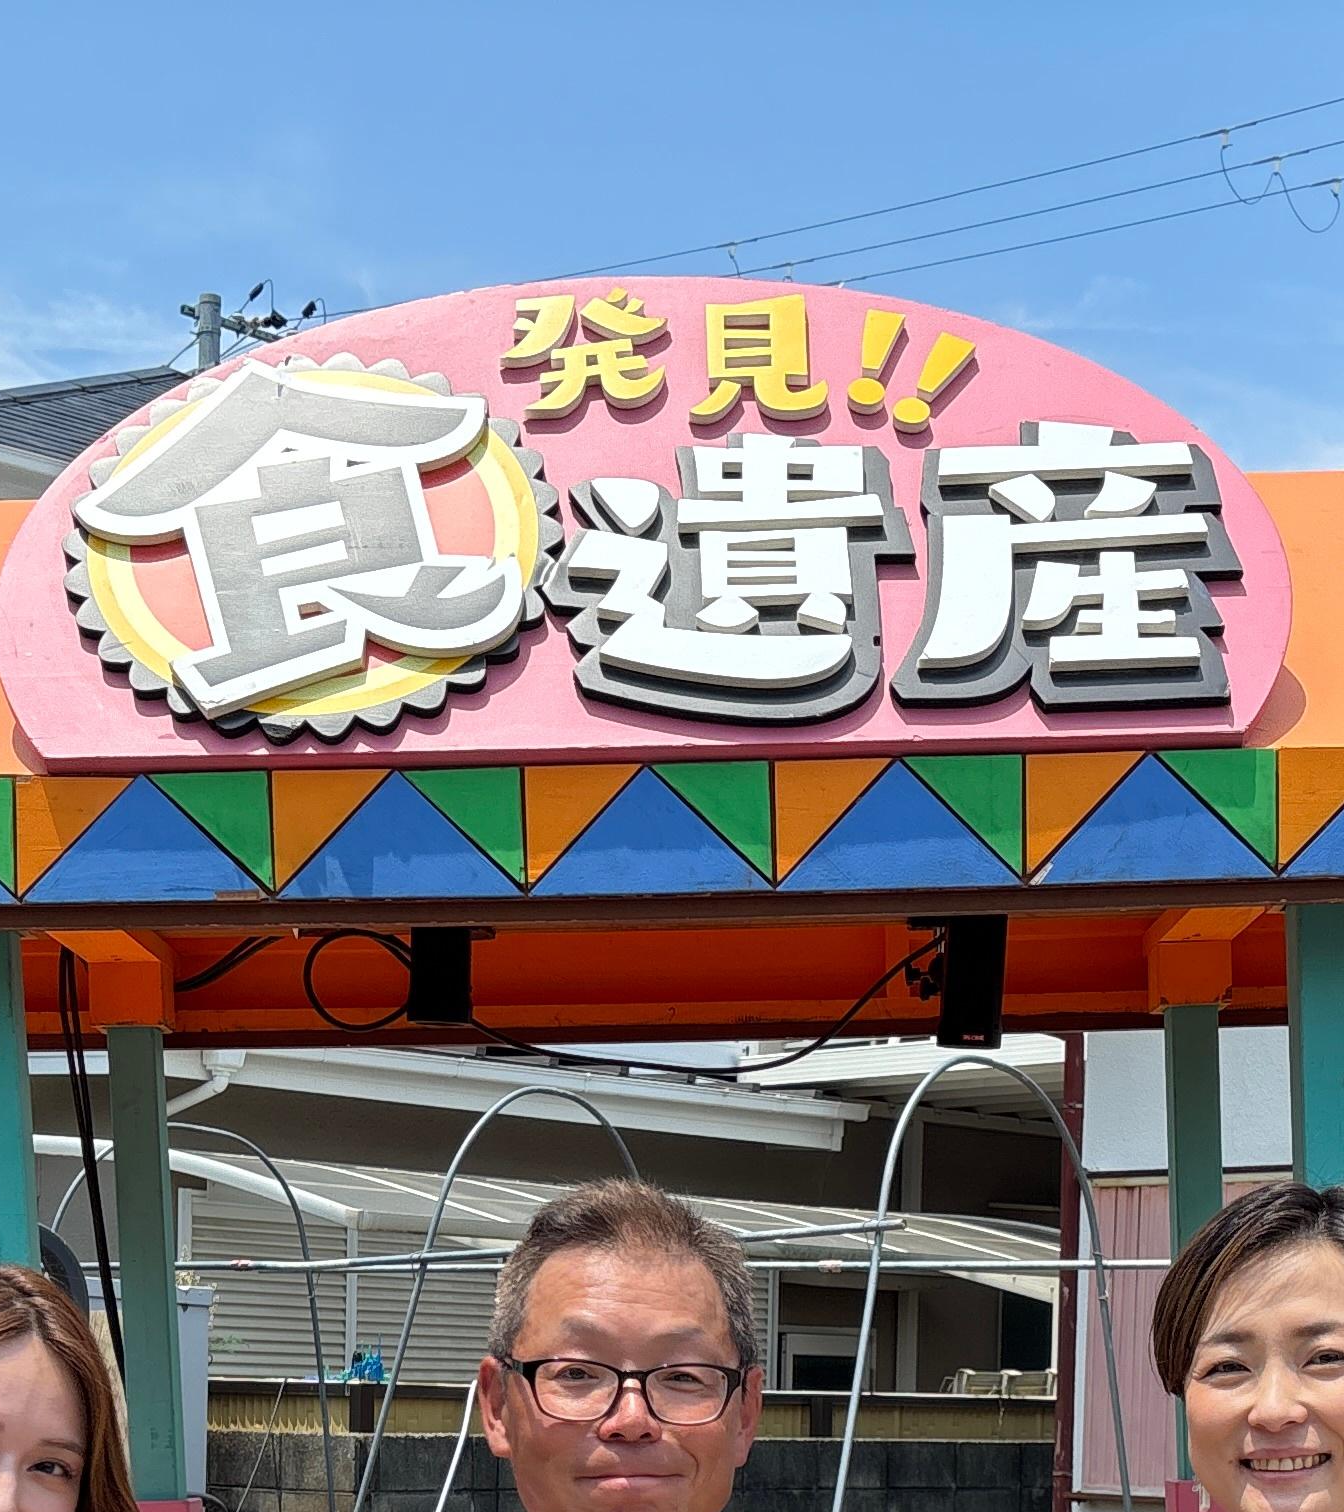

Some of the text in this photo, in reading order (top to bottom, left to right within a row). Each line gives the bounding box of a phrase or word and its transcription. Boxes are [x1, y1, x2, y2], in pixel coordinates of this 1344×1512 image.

[500, 288, 976, 434] 発見!!
[70, 362, 1244, 730] 食遺産
